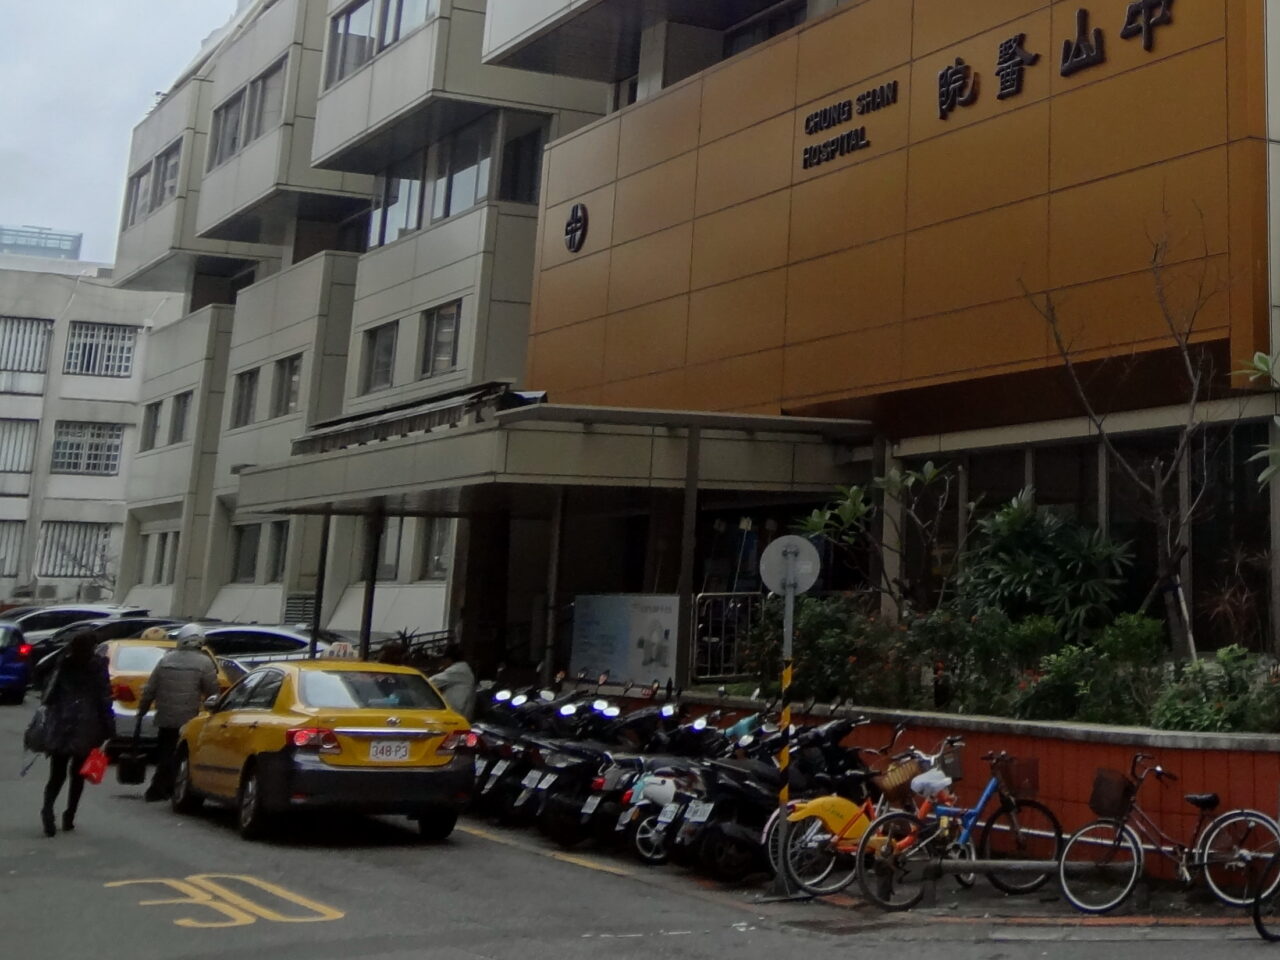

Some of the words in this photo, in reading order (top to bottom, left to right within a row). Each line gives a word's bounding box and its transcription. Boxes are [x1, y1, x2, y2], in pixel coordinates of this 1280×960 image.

[804, 100, 853, 135] CHUNG
[856, 80, 898, 115] SHAN
[802, 126, 871, 169] HOSPITAL
[103, 873, 346, 929] 30
